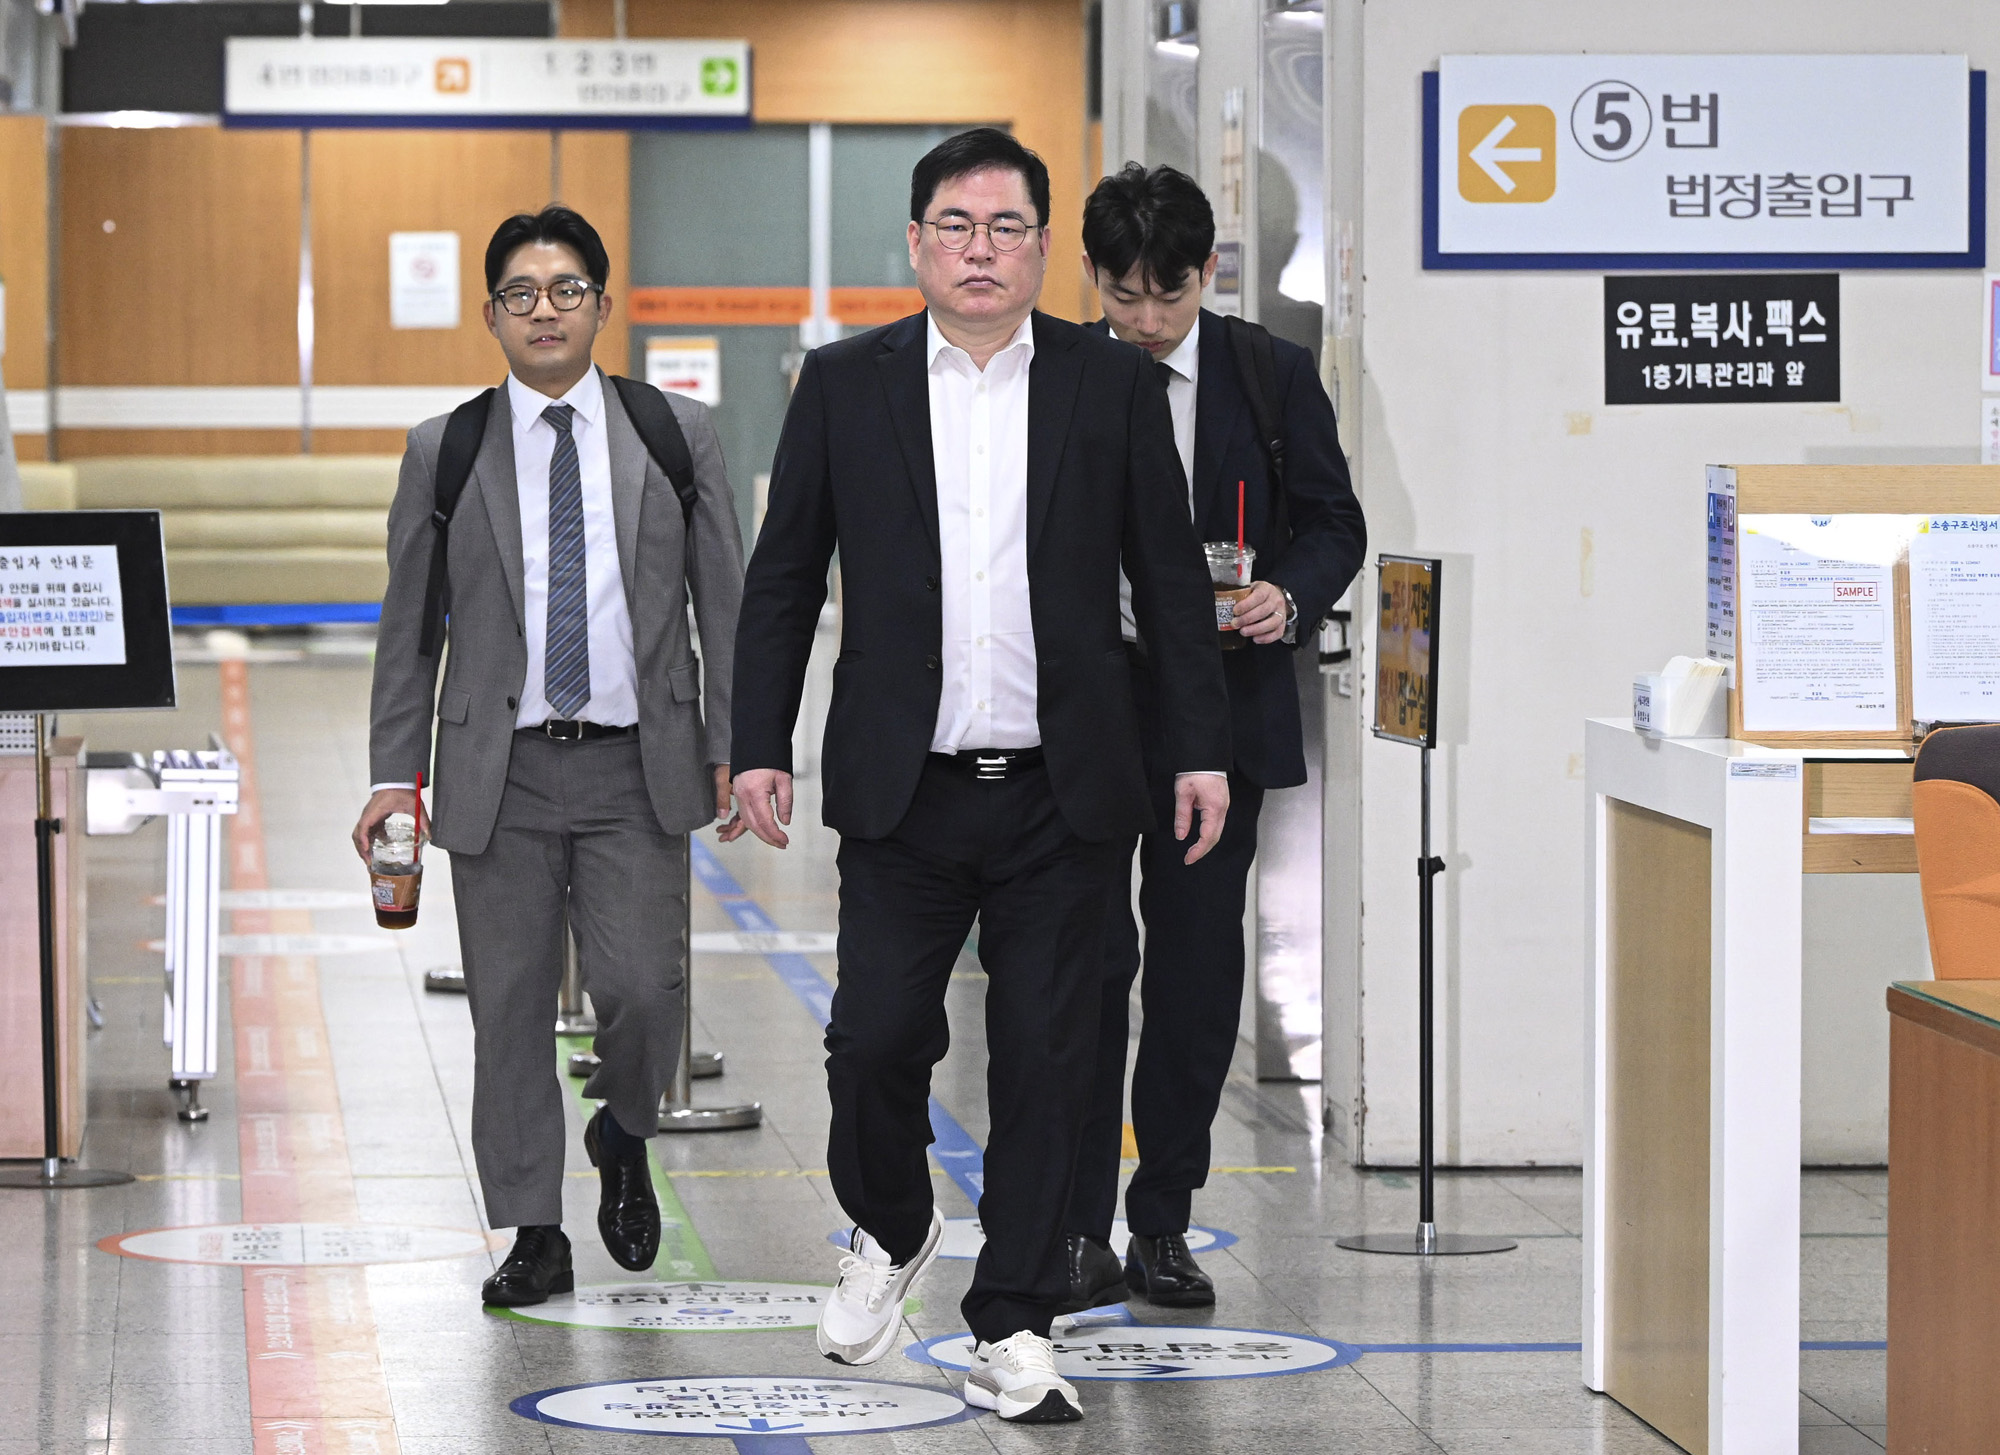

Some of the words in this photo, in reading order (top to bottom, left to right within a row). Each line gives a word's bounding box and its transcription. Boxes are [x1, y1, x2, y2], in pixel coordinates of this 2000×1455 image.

[1665, 172, 1916, 220] 법정출입구
[1616, 300, 1827, 350] 유료.복사.팩스
[1642, 361, 1775, 390] 1층기록관리과
[1785, 361, 1805, 386] 앞
[1931, 520, 1998, 532] 소송구조신청서
[50, 556, 94, 570] 안내문
[46, 583, 66, 594] 위해
[72, 583, 102, 594] 출입시
[1836, 586, 1874, 597] SAMPLE
[27, 598, 66, 608] 실시하고
[71, 597, 114, 607] 있습니다.
[62, 625, 95, 636] 협조해
